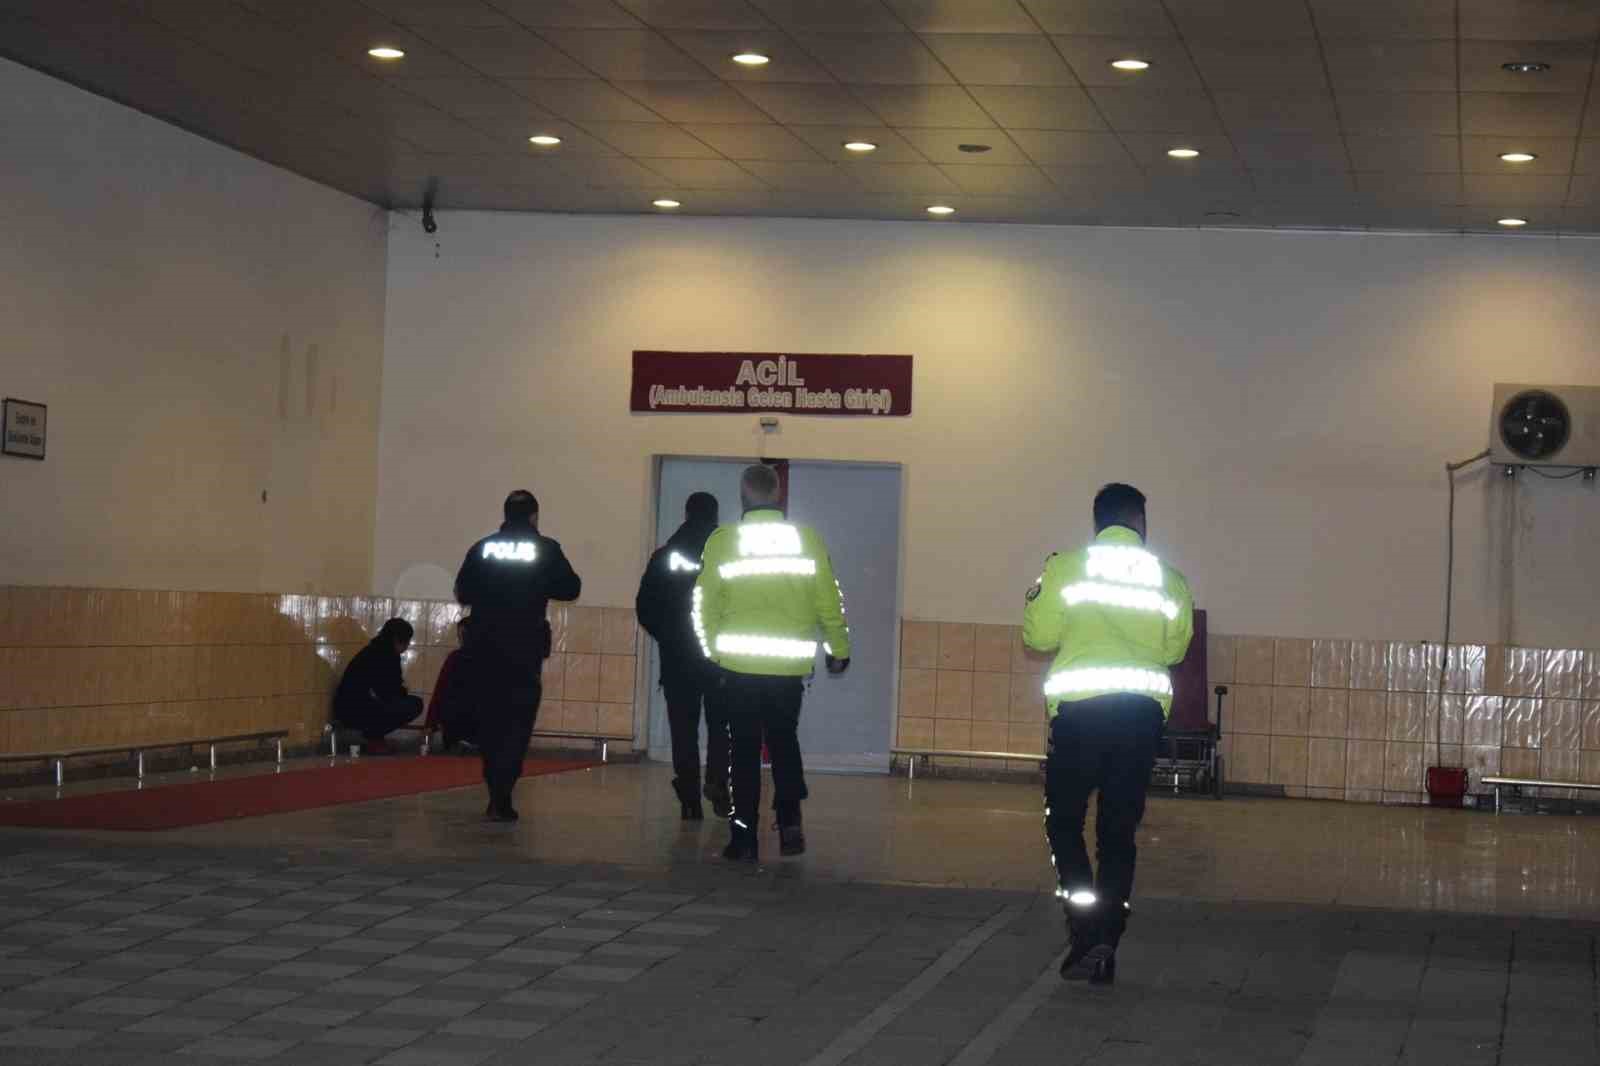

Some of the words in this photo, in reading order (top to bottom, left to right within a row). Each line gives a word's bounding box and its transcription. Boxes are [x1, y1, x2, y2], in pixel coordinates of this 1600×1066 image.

[735, 355, 805, 386] ACİL
[648, 384, 745, 408] (Ambulansla
[747, 386, 793, 408] Gelen
[795, 387, 842, 409] Hasta
